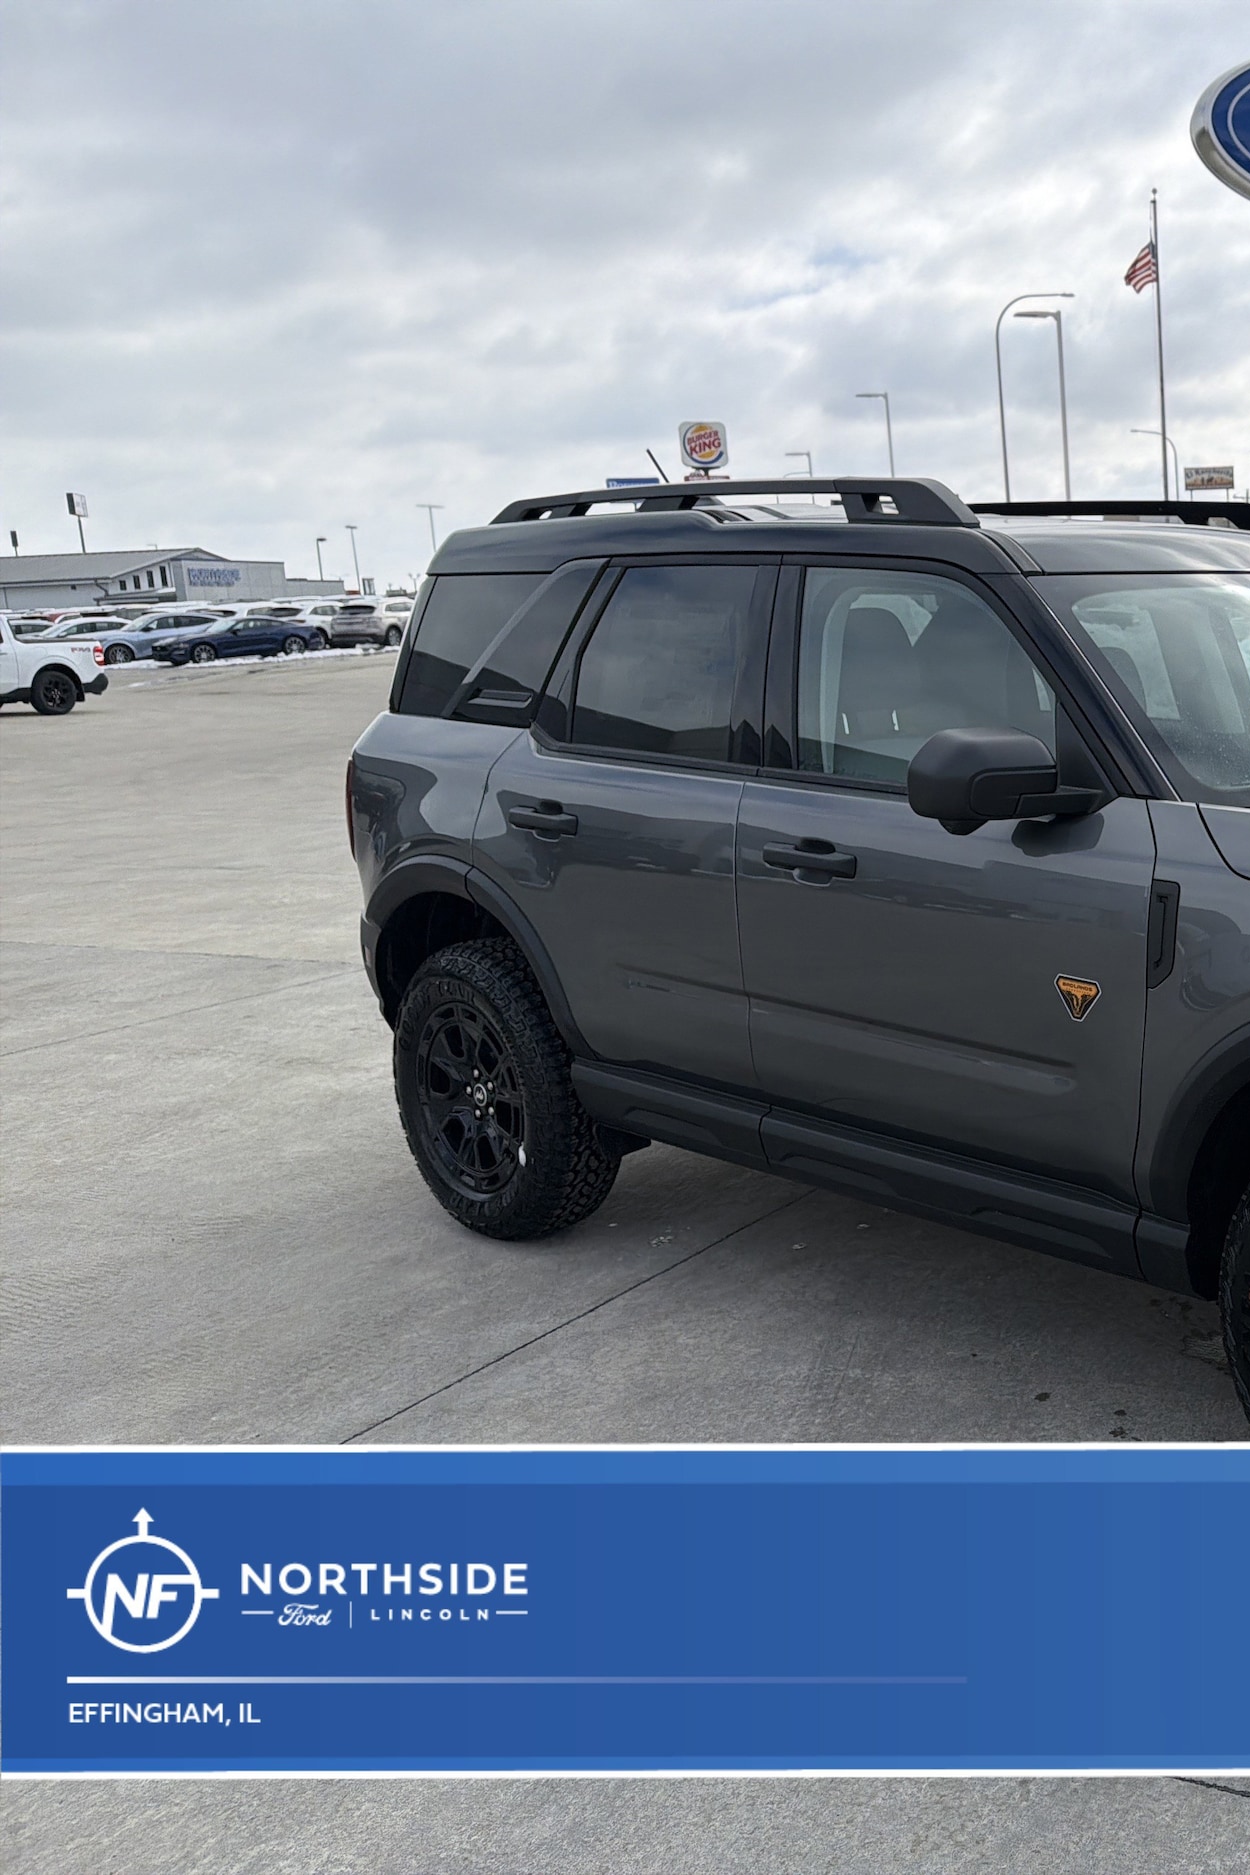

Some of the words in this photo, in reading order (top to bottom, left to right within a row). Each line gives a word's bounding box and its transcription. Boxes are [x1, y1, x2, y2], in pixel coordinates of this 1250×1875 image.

[687, 430, 720, 447] BURGER
[689, 438, 722, 456] KING
[1062, 981, 1093, 992] BADLANDS
